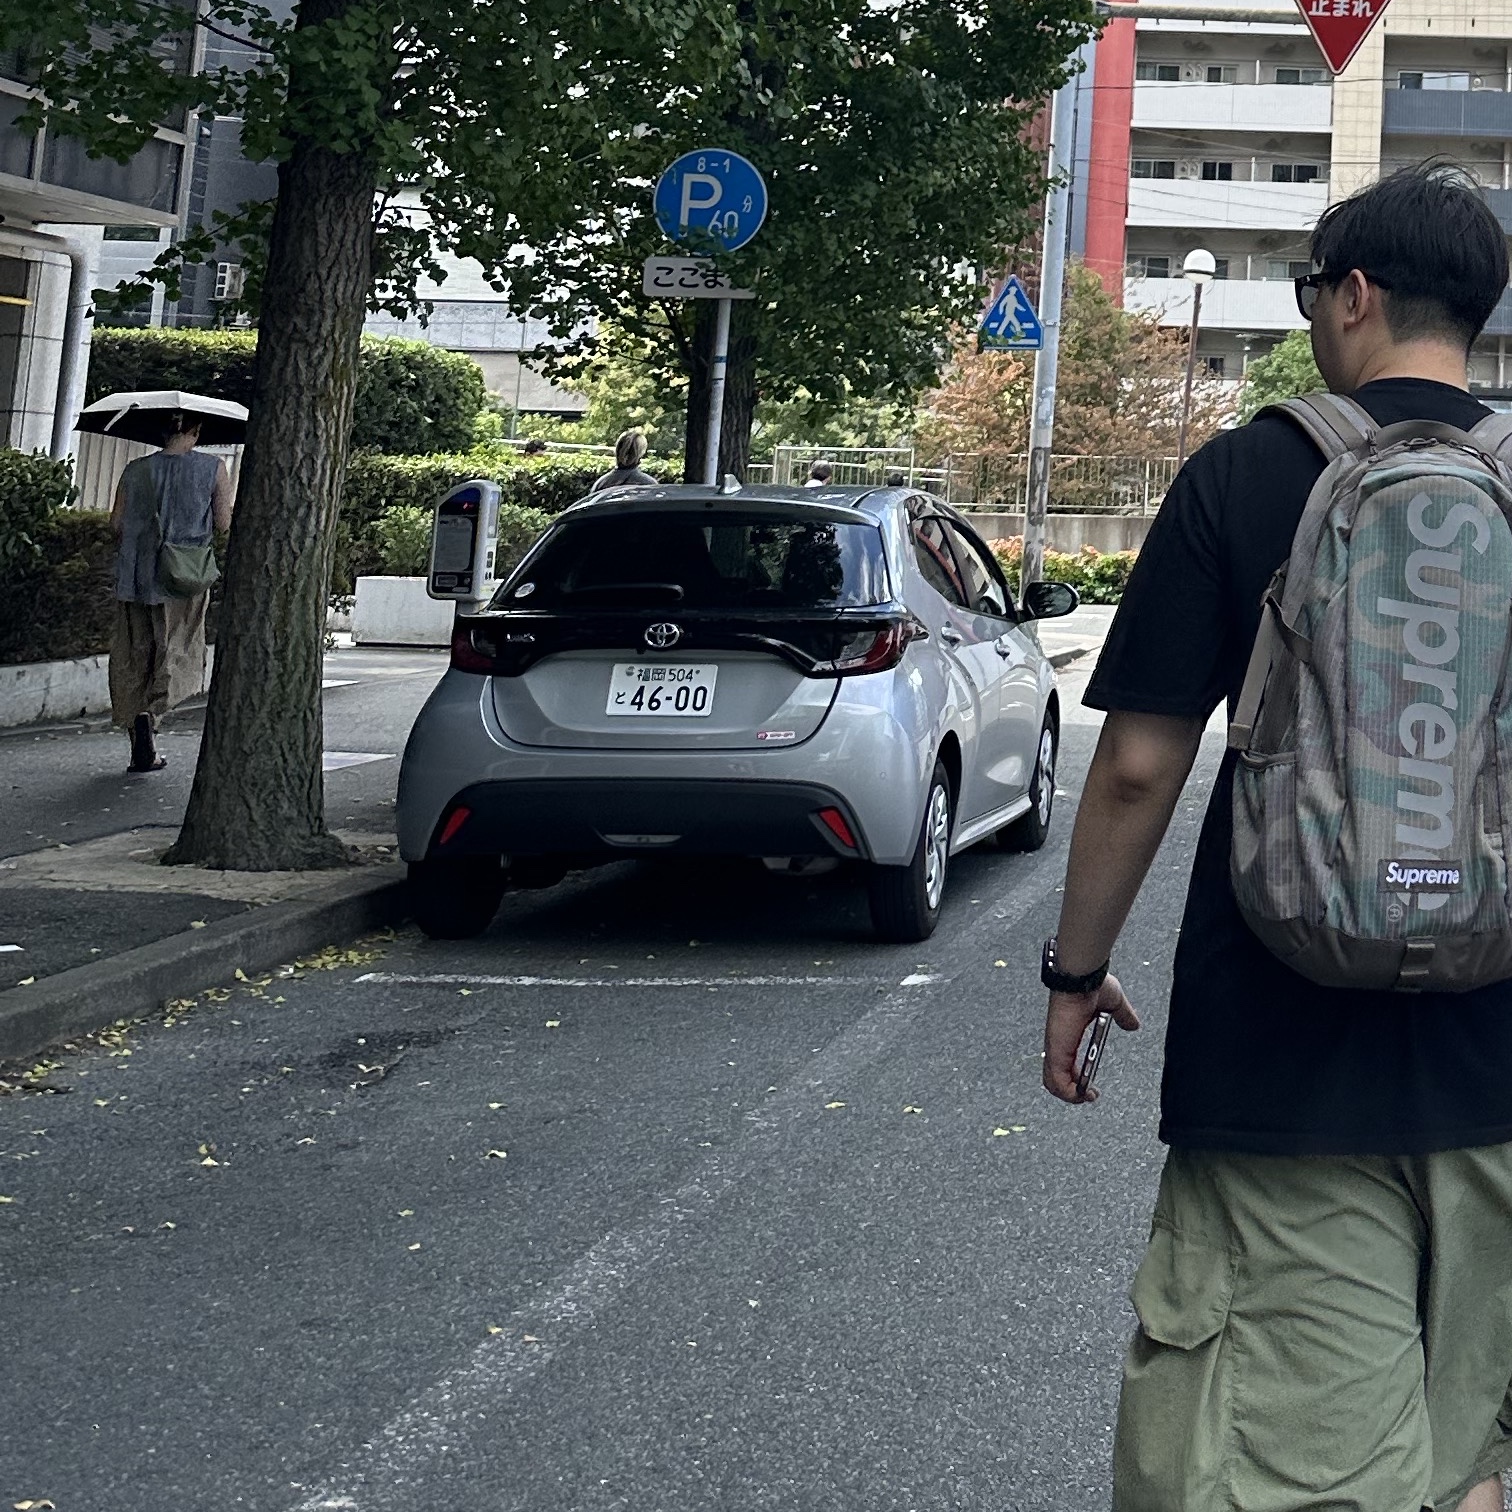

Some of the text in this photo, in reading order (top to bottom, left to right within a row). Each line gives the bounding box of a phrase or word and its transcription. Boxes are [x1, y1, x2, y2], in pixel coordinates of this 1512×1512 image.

[678, 172, 723, 238] P
[653, 265, 726, 289] ここま
[667, 668, 694, 682] 504
[615, 685, 708, 712] と 46-00
